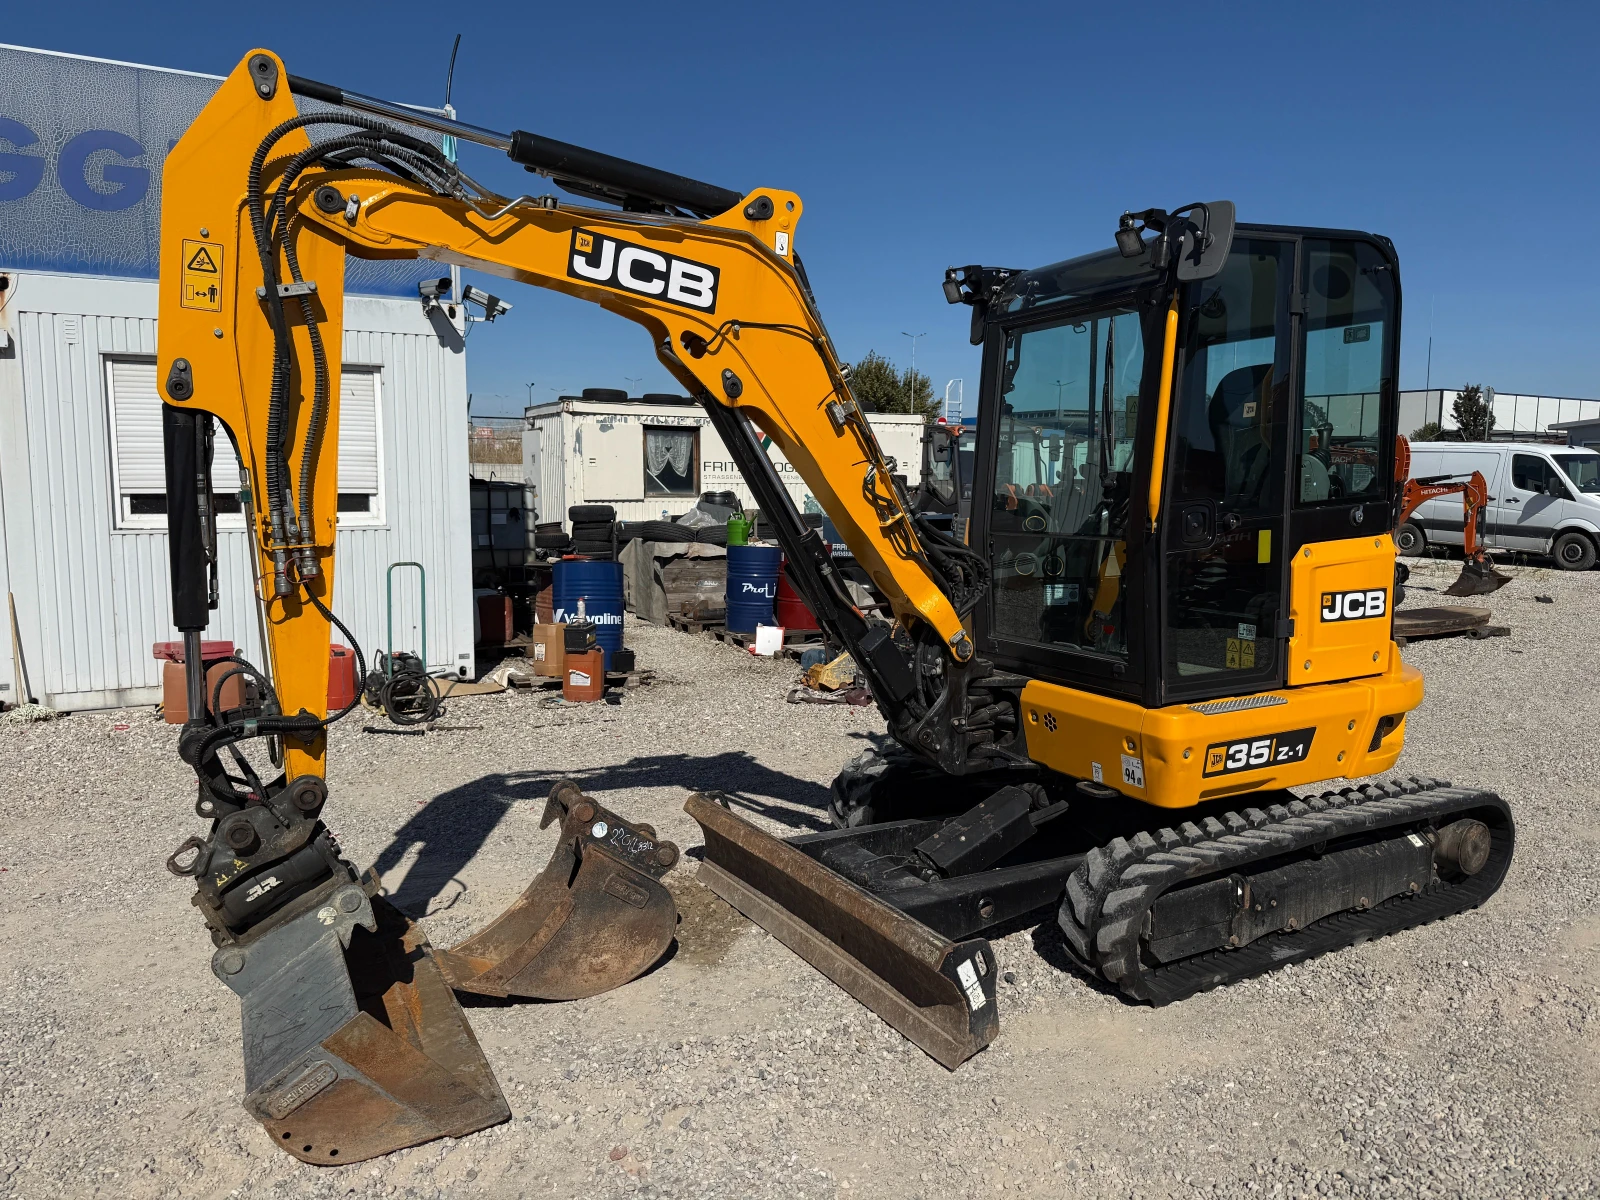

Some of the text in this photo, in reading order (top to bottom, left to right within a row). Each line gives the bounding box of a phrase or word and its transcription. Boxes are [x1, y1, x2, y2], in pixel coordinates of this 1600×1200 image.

[573, 239, 715, 308] JCB
[703, 461, 796, 472] FRIT OG
[1322, 591, 1385, 620] JCB
[1226, 739, 1304, 769] 35 Z-1
[1124, 767, 1136, 784] 94
